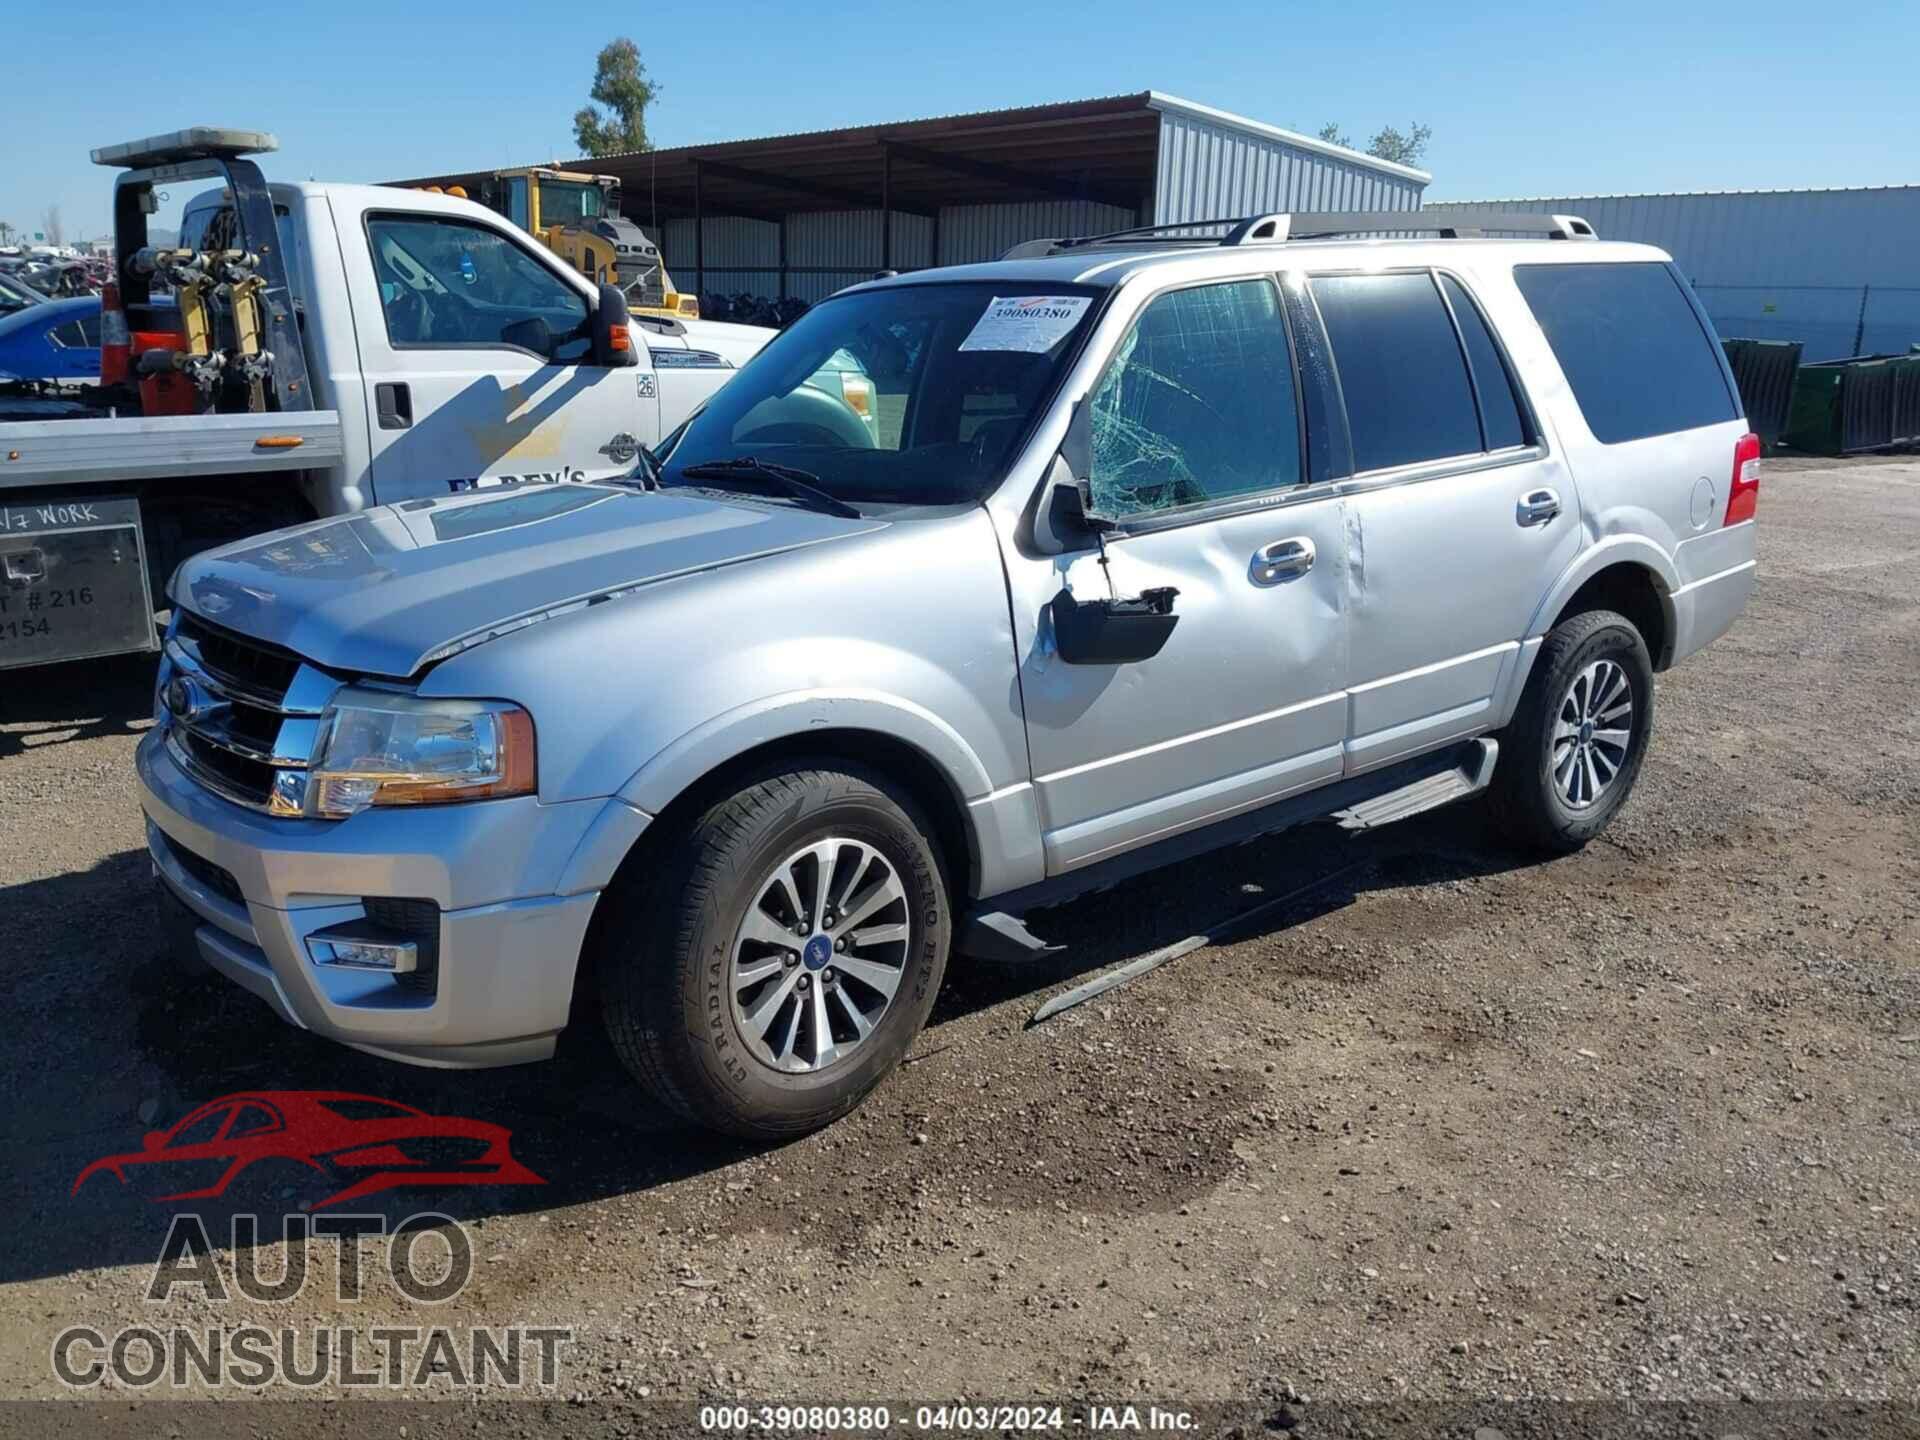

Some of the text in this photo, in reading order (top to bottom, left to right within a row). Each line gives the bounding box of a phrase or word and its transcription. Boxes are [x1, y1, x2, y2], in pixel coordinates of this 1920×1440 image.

[639, 380, 654, 396] 26
[36, 503, 100, 526] WORK
[49, 586, 95, 609] 216
[707, 940, 729, 1050] RADIAL
